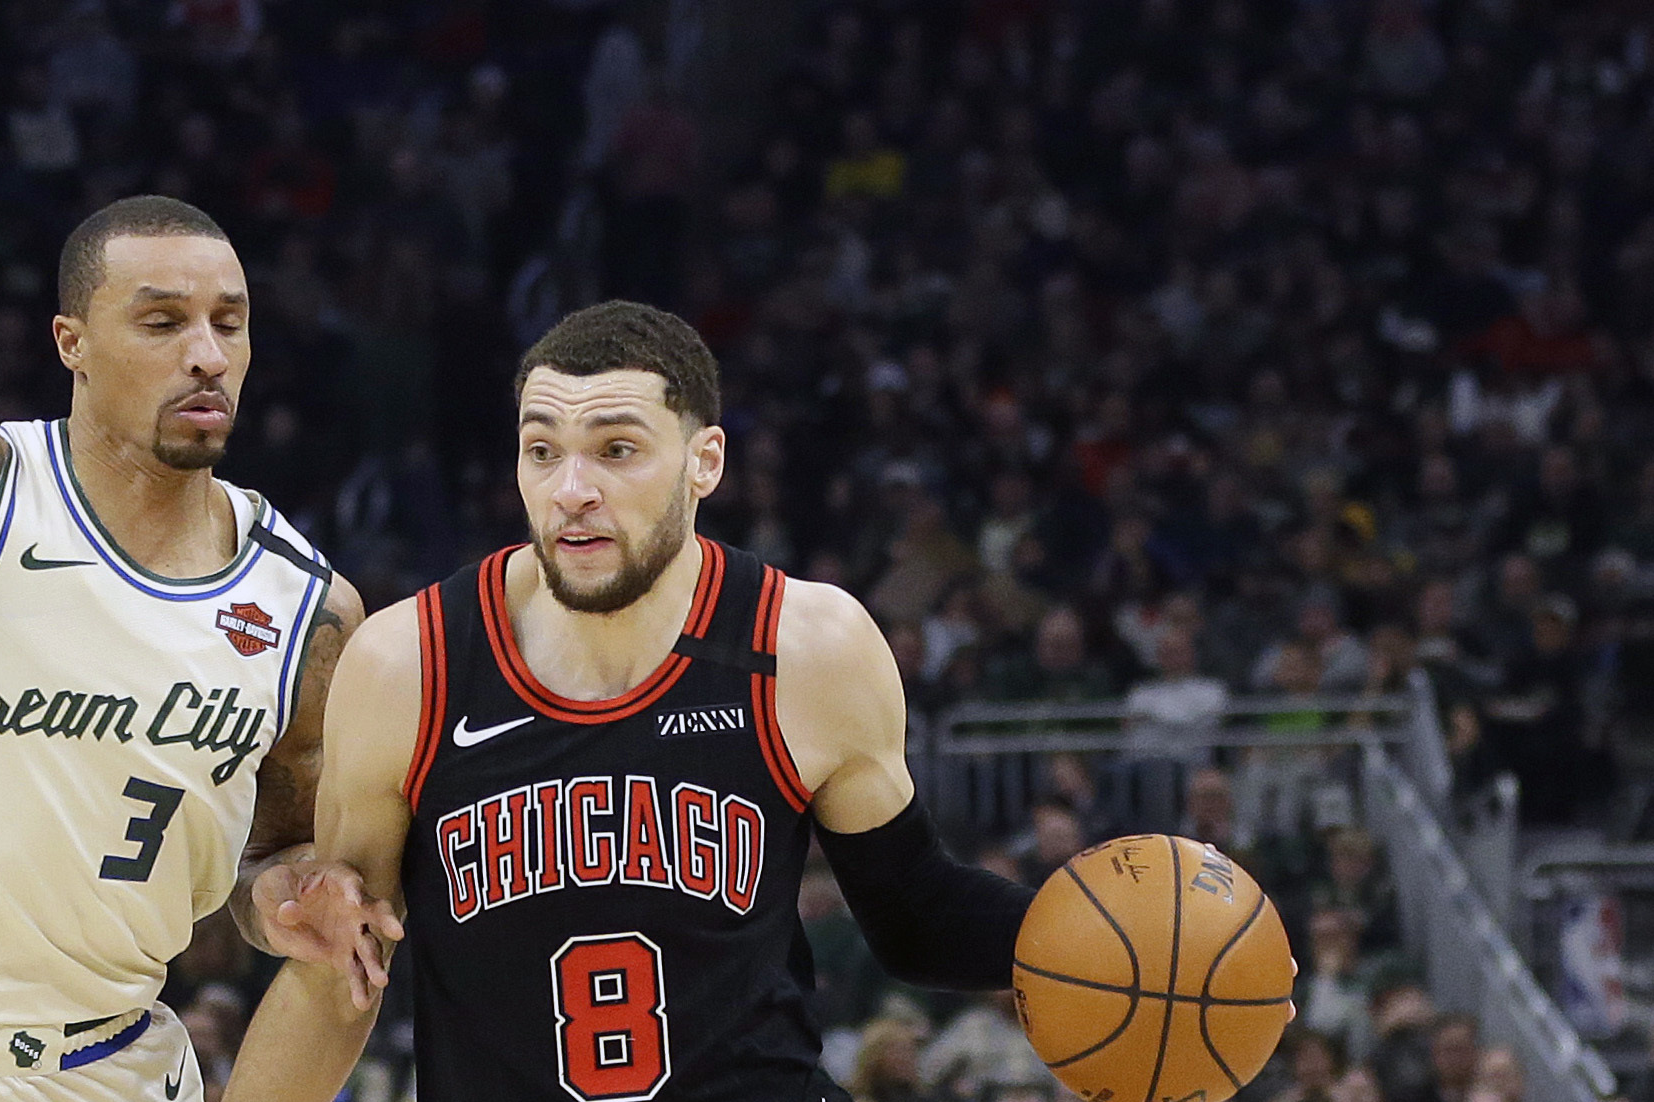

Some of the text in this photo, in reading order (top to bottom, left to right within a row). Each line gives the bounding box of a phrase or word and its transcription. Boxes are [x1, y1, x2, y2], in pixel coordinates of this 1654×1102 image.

[145, 681, 267, 786] City
[98, 776, 186, 882] 3
[436, 775, 765, 923] CHICAGO
